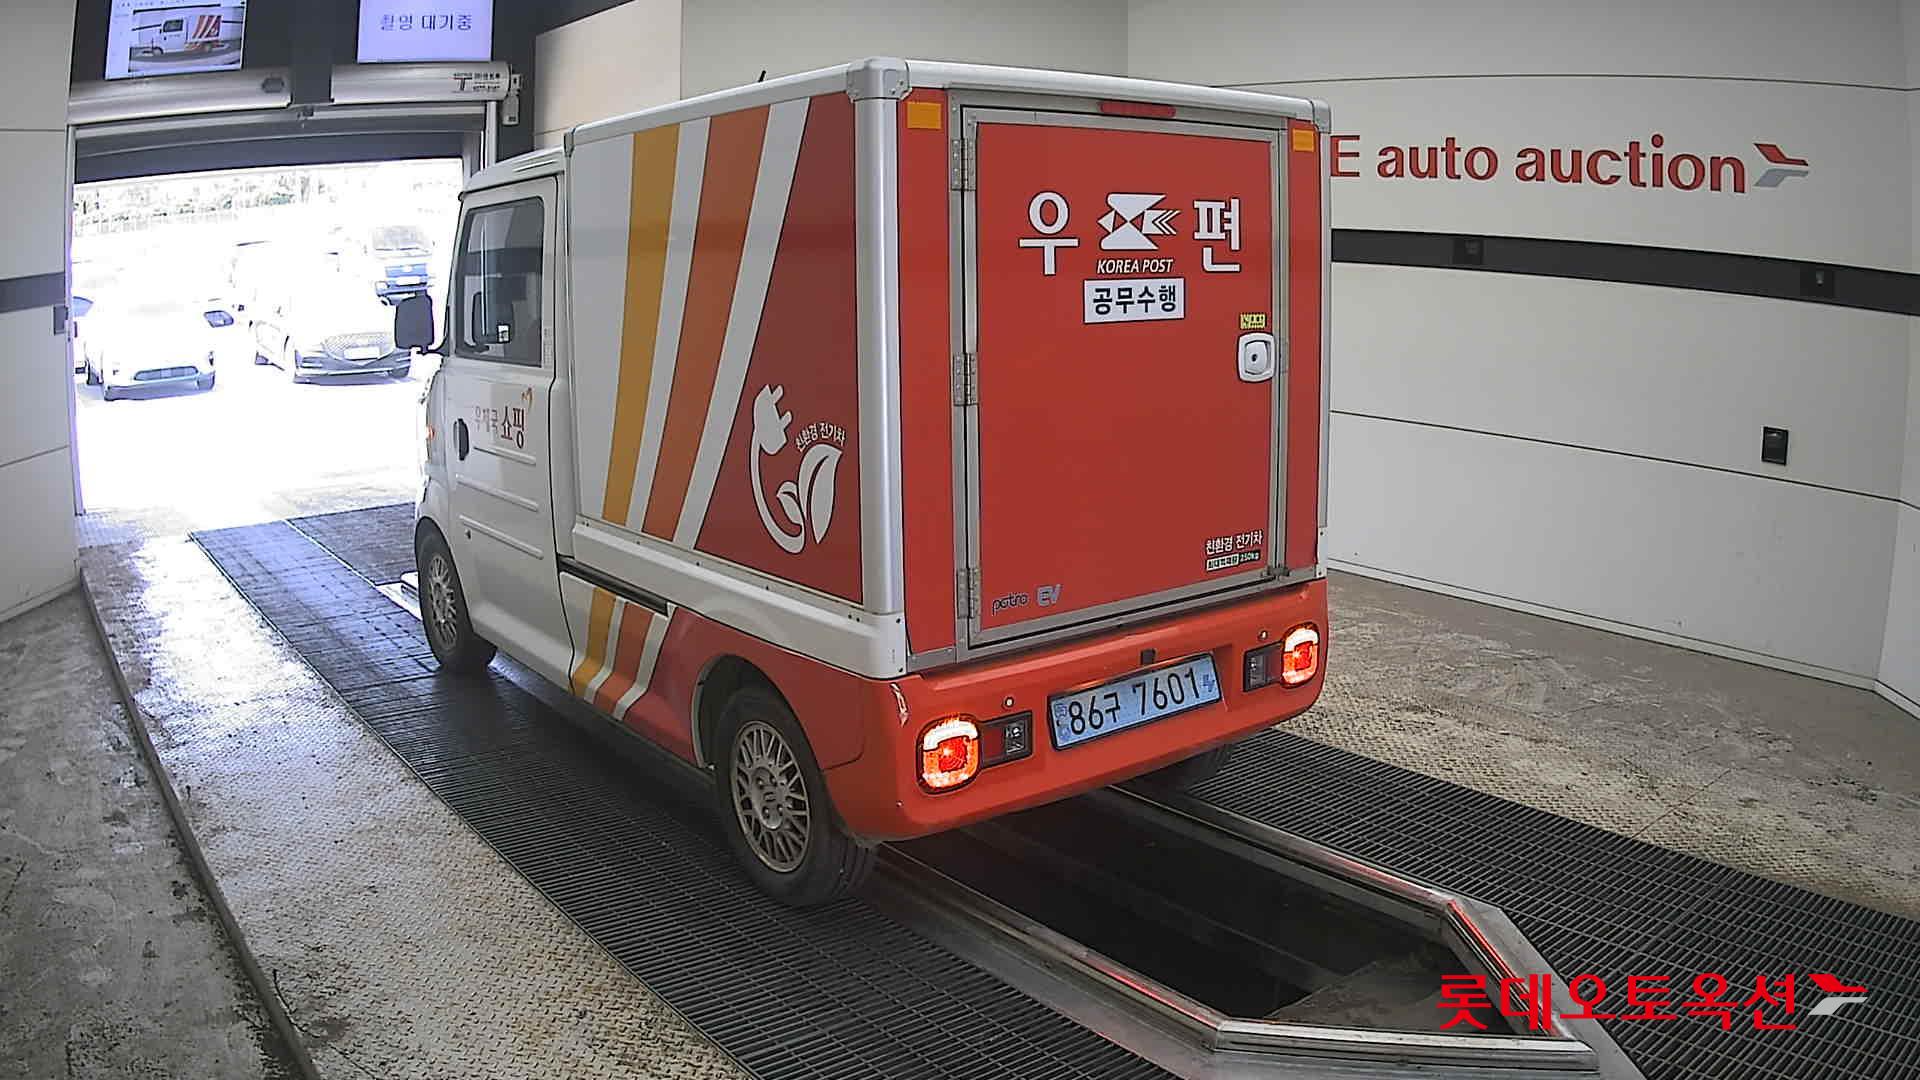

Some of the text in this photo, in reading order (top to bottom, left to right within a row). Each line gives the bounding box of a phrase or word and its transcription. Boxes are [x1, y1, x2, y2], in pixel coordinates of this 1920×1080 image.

[421, 13, 472, 31] 대기중
[1330, 133, 1746, 194] E auto auction
[1097, 258, 1174, 274] KOREA POST
[1093, 285, 1176, 315] 공무수행
[819, 421, 846, 447] 전기차
[1206, 529, 1263, 555] 친환경 전기차
[1068, 692, 1121, 735] 86구
[1132, 667, 1199, 716] 7601
